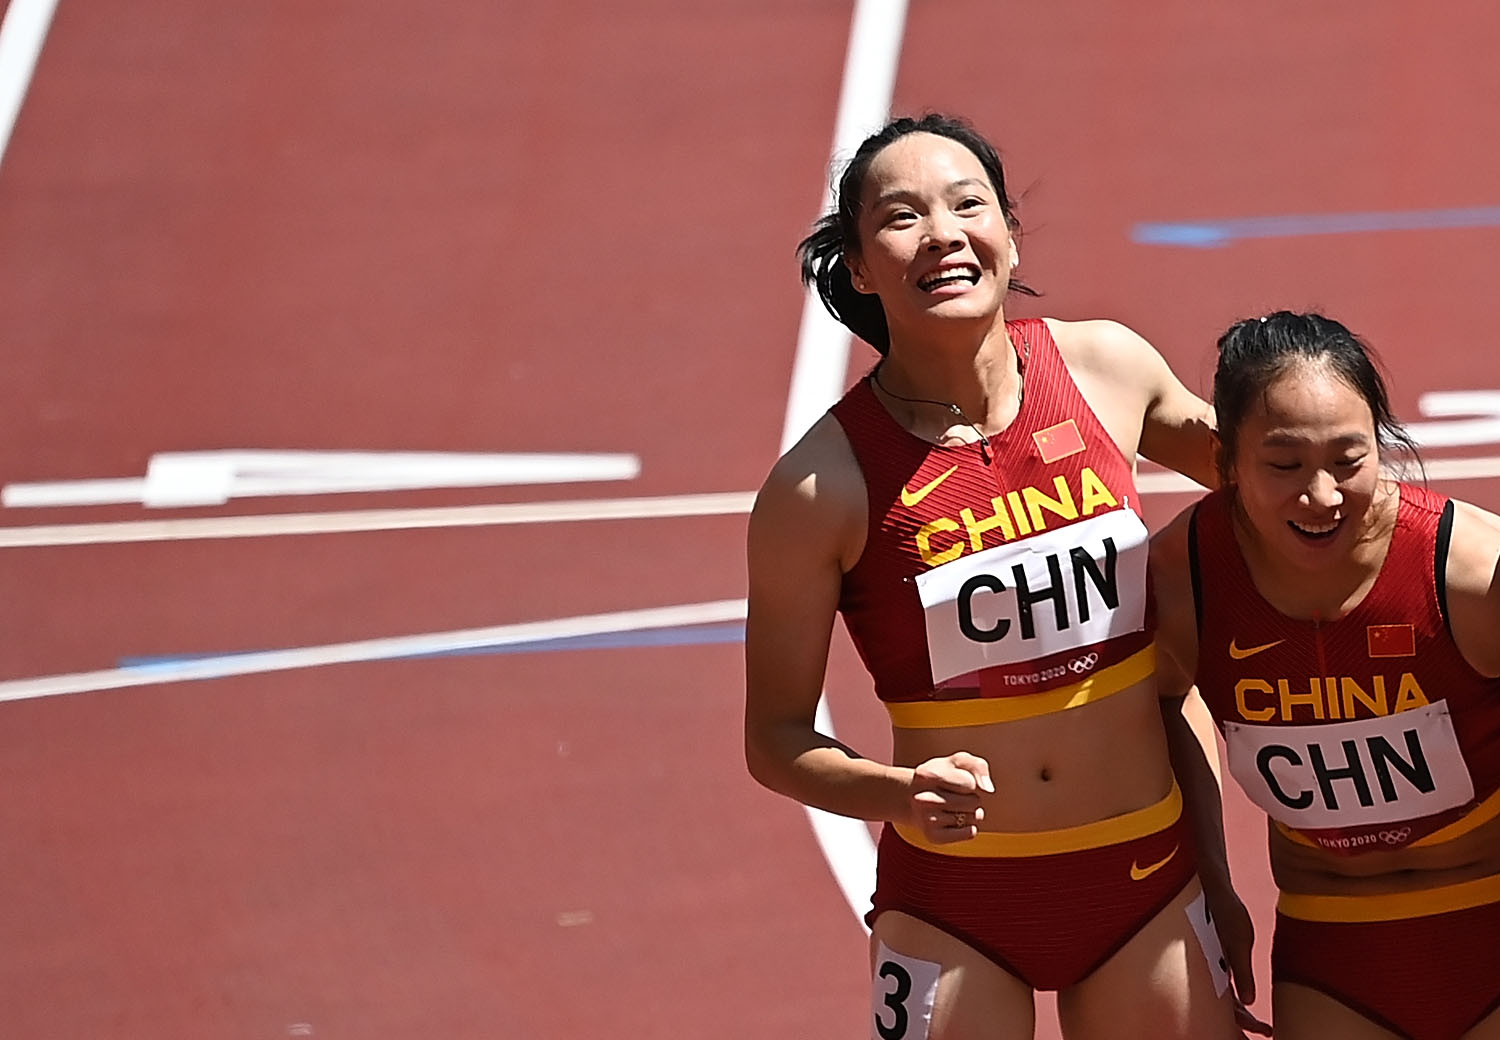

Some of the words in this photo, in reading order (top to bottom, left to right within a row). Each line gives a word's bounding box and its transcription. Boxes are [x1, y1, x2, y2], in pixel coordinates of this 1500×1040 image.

[915, 467, 1119, 567] CHINA
[956, 536, 1119, 643] CHN
[1003, 673, 1040, 686] TOKYO
[1041, 665, 1066, 681] 2020
[1234, 672, 1431, 722] CHINA
[1256, 729, 1436, 811] CHN
[1318, 837, 1350, 848] TOKYO
[1351, 834, 1377, 847] 2020
